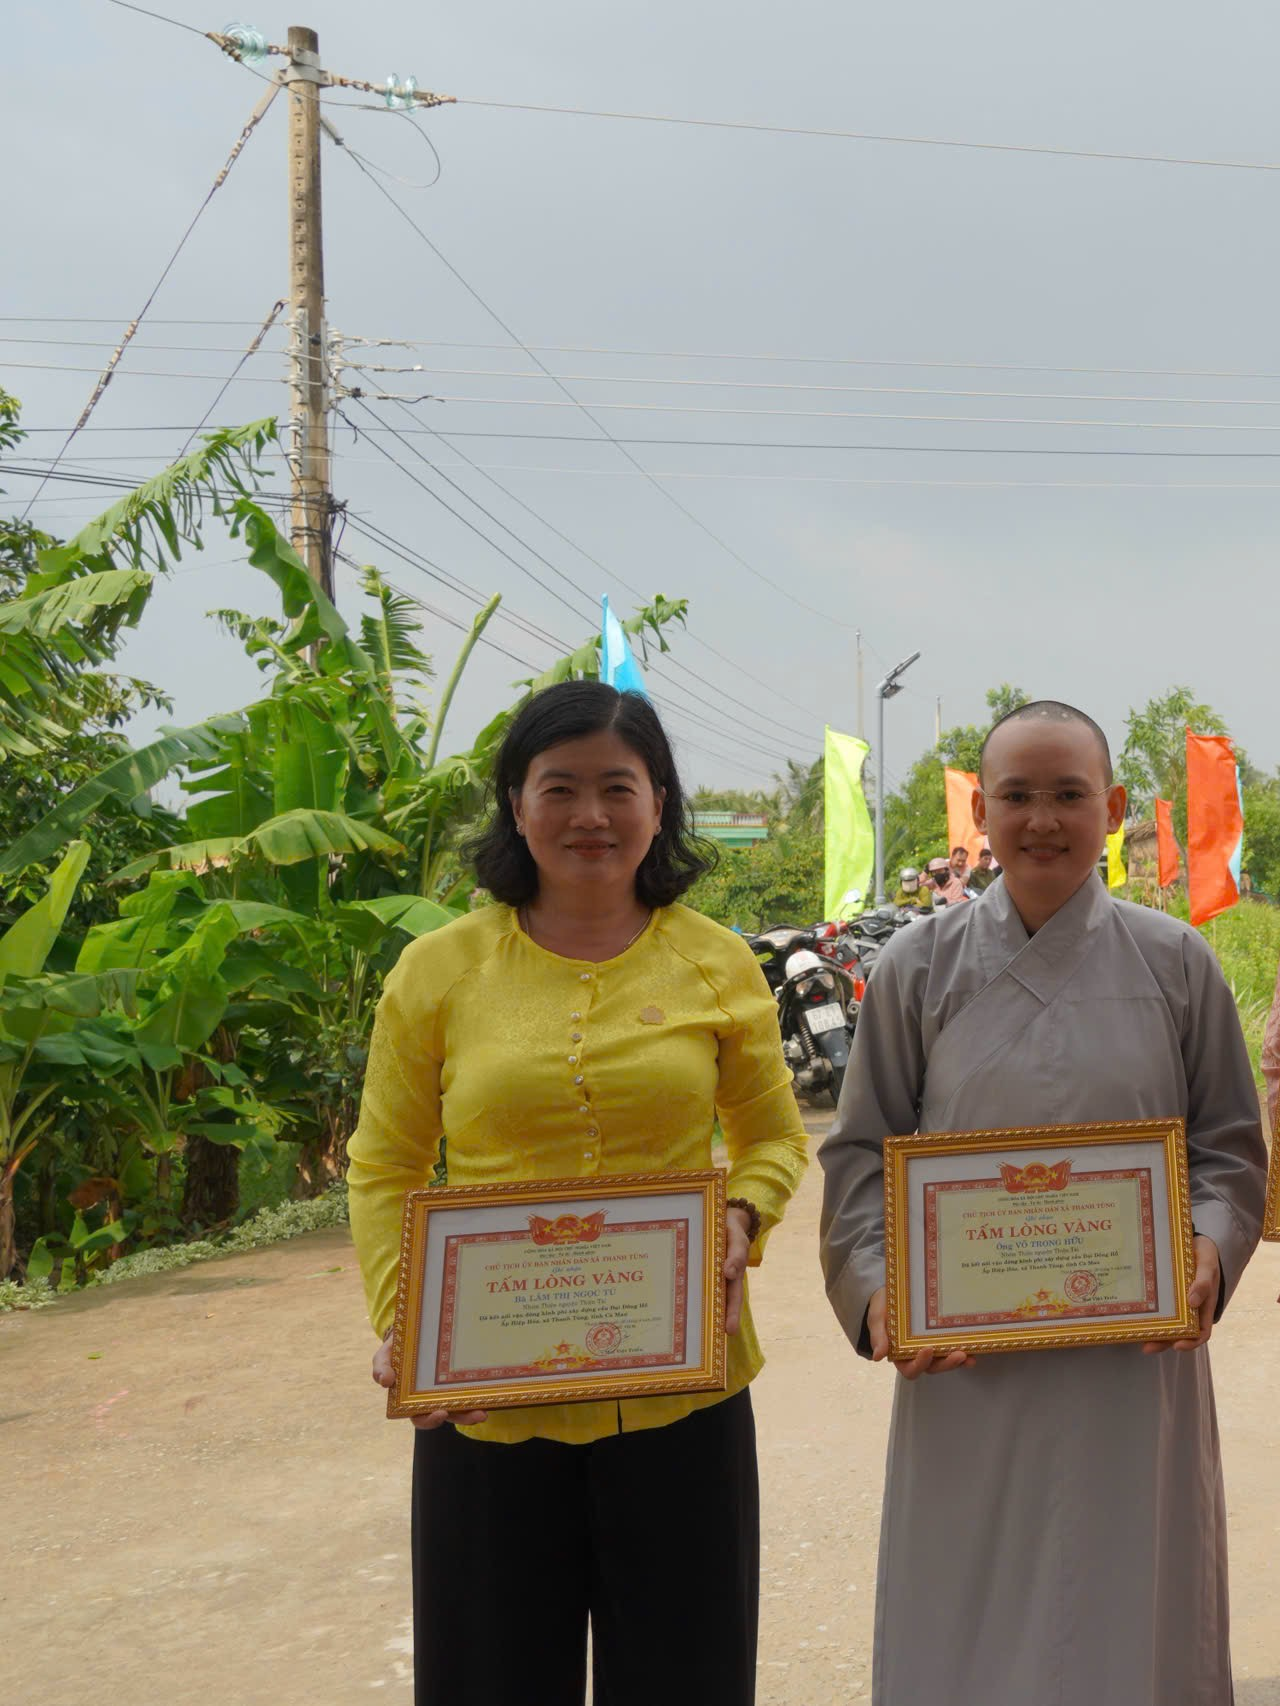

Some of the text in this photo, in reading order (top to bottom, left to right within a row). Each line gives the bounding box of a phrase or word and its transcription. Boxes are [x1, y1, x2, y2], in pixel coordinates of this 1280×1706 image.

[966, 1218, 1111, 1240] TẤM LÒNG VÀNG
[487, 1269, 644, 1293] TẤM LÒNG VÀNG
